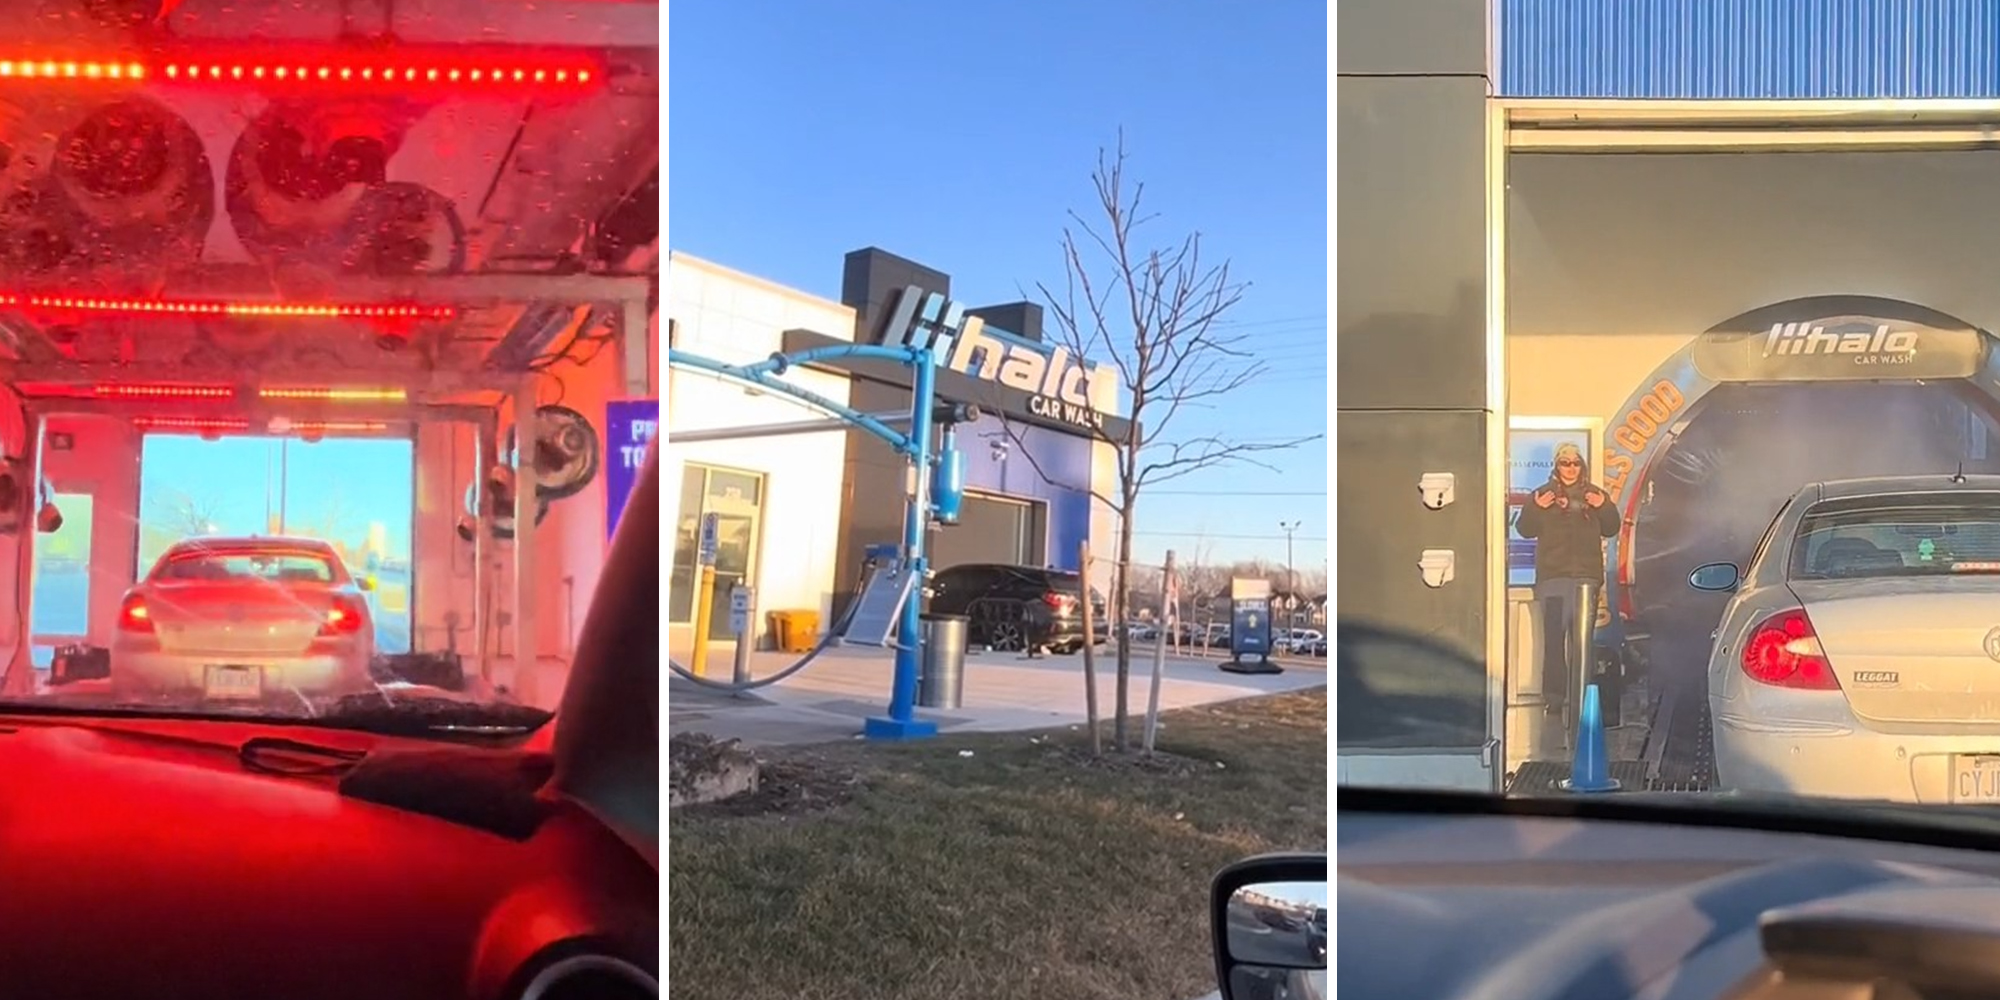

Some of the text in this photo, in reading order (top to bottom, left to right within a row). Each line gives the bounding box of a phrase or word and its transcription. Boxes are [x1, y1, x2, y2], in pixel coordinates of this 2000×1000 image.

[1854, 354, 1913, 365] CAR WASH
[1030, 395, 1060, 420] CAR
[1613, 379, 1685, 454] GOOD
[1856, 672, 1896, 682] LEGGAT
